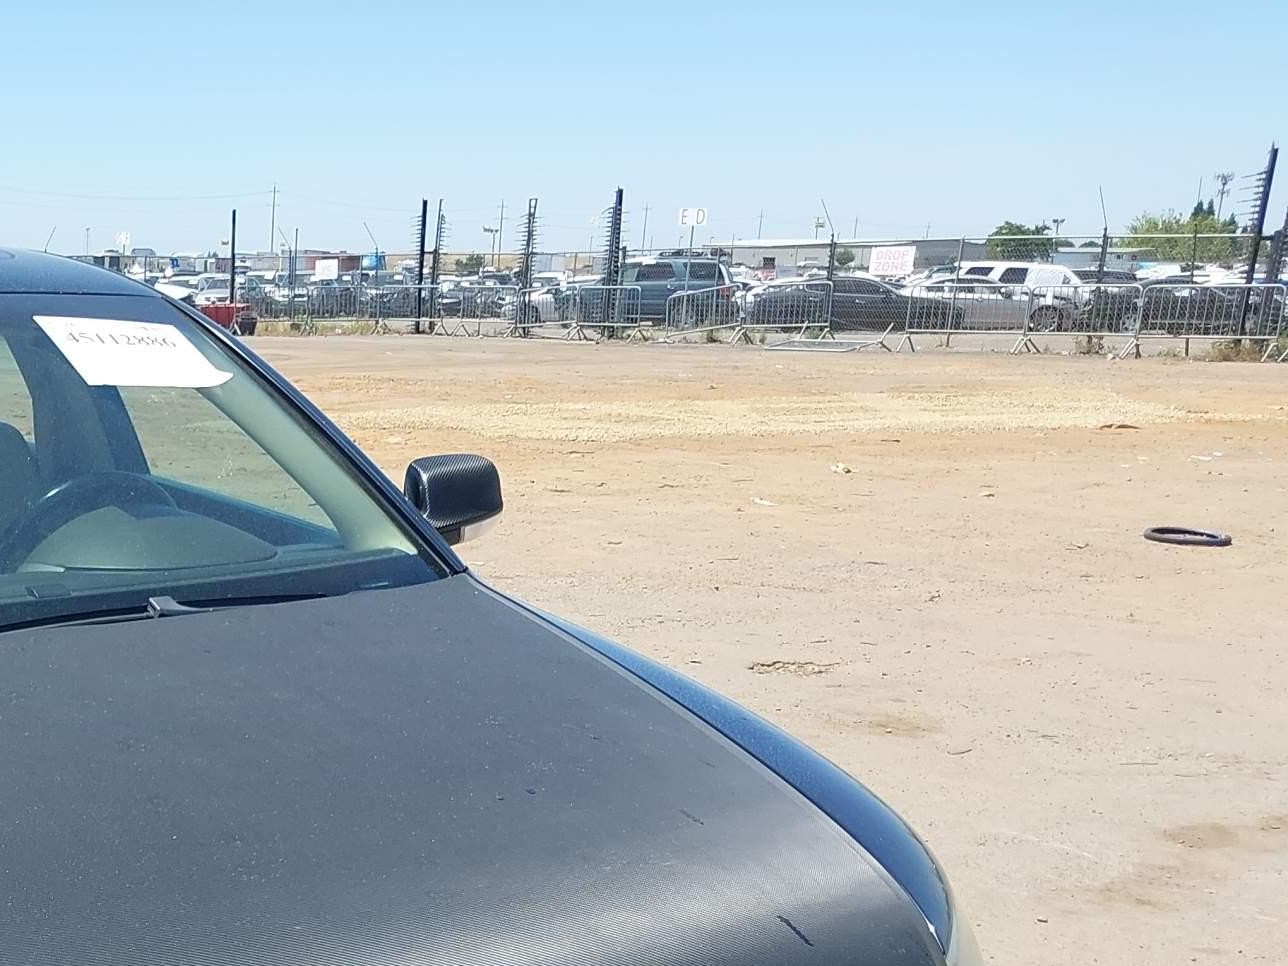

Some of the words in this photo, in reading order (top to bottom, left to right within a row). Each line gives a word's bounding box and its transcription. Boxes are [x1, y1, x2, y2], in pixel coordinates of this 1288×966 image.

[681, 208, 689, 225] E
[876, 249, 910, 261] DROP
[872, 261, 909, 273] ZONE
[66, 331, 177, 349] 45112886
